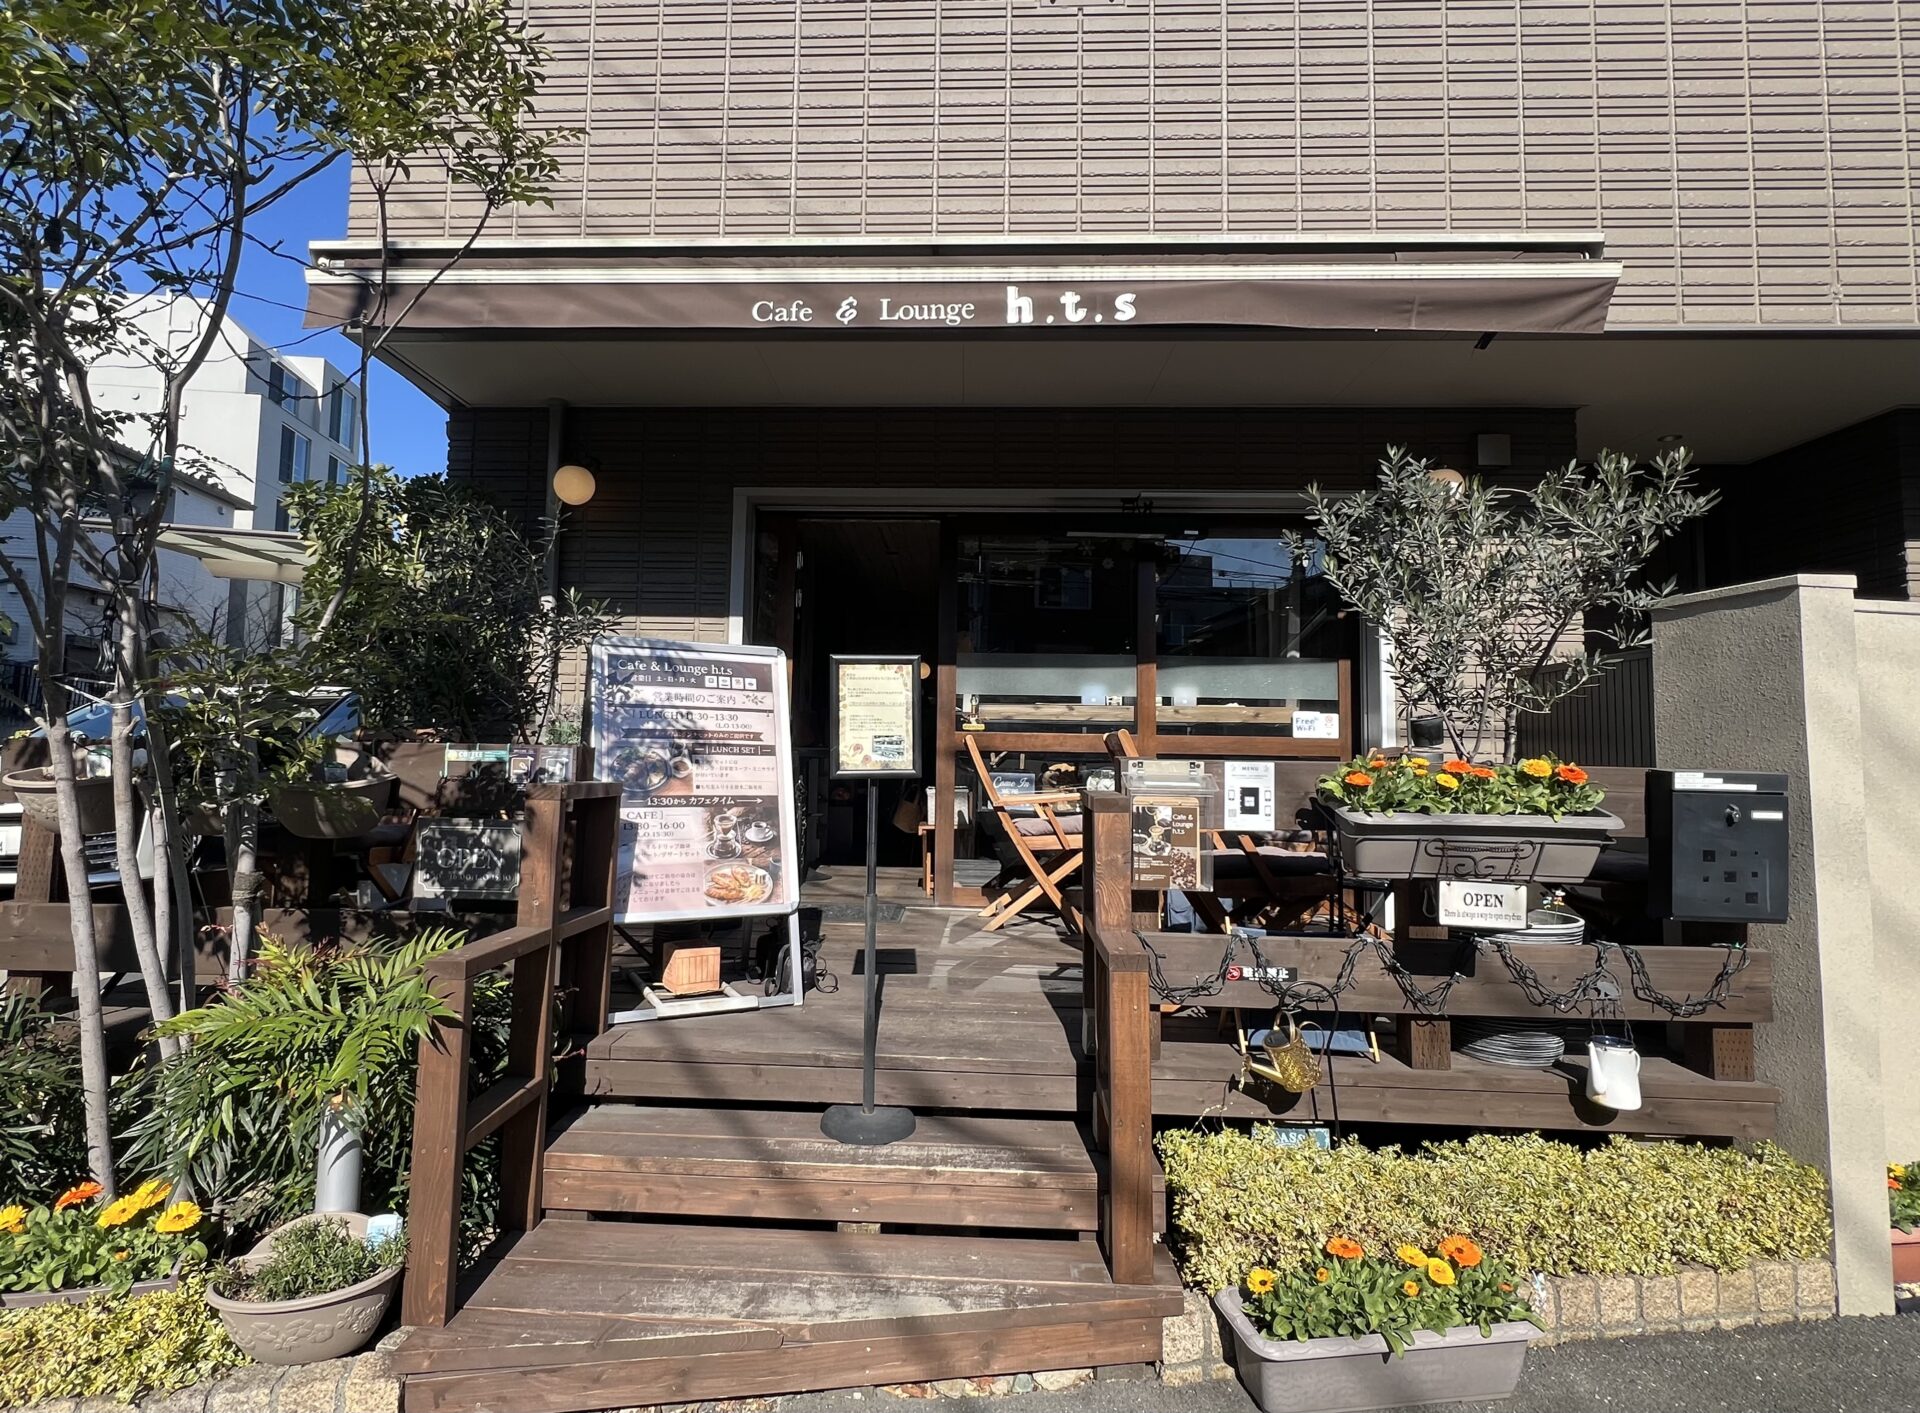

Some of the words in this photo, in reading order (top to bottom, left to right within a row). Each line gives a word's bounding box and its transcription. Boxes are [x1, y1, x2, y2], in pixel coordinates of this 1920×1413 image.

[751, 299, 813, 323] Cafe
[836, 296, 858, 325] &
[879, 298, 976, 326] Lounge
[1006, 286, 1138, 324] h.t.s
[618, 659, 647, 671] Cafe
[650, 661, 661, 672] &
[664, 662, 708, 676] Lounge
[1295, 717, 1315, 725] Free
[993, 776, 1016, 789] Come
[1017, 777, 1030, 788] In
[689, 796, 735, 805] カフェタイム
[626, 811, 658, 820] CAFE
[1172, 813, 1187, 821] Cafe
[1172, 821, 1194, 829] Lounge
[436, 847, 504, 869] OPEN
[1463, 892, 1504, 908] OPEN
